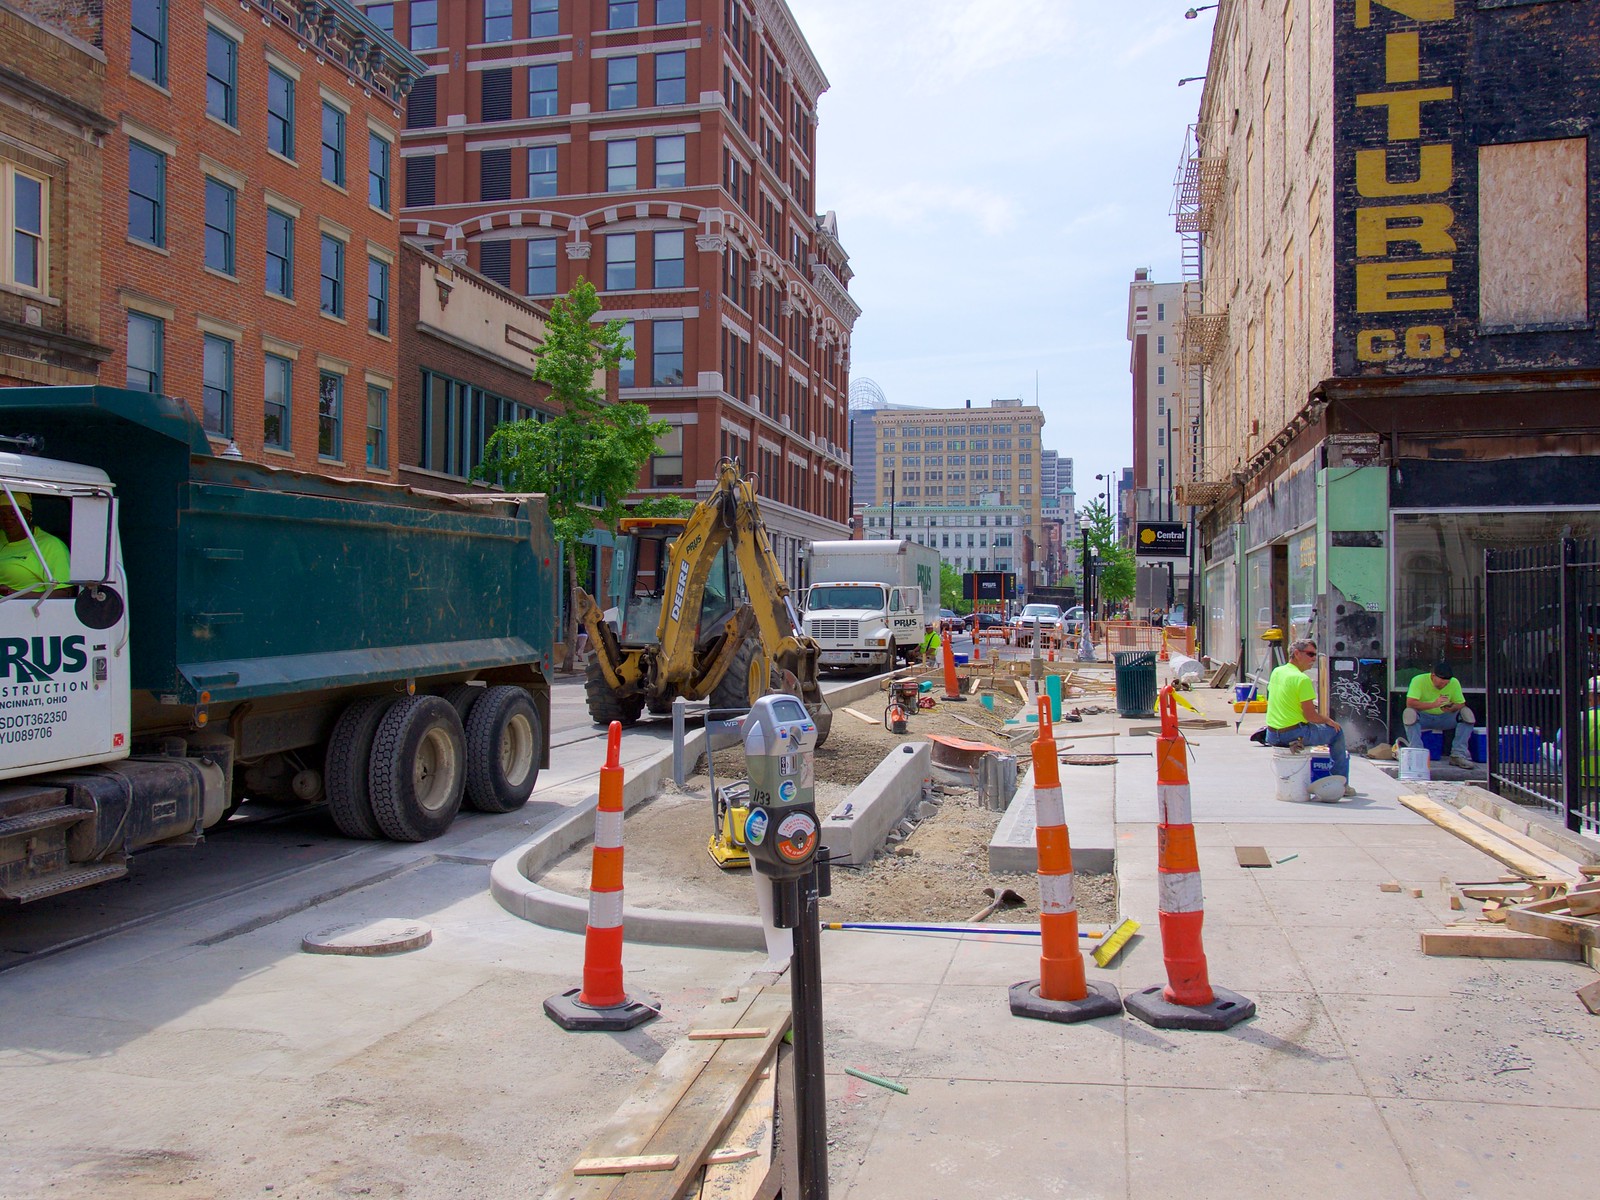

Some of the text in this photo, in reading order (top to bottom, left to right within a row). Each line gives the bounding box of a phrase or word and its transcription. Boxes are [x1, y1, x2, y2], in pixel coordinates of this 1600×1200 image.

[1356, 325, 1461, 361] CO.
[1156, 531, 1185, 539] Central
[686, 534, 702, 555] PRUS
[671, 559, 690, 623] DEERE
[893, 618, 917, 628] PRUS
[2, 681, 88, 697] STRUCTION
[46, 695, 67, 705] OHIO
[0, 710, 67, 730] SDOT362350
[0, 726, 52, 744] YU089706
[753, 788, 771, 806] 1133
